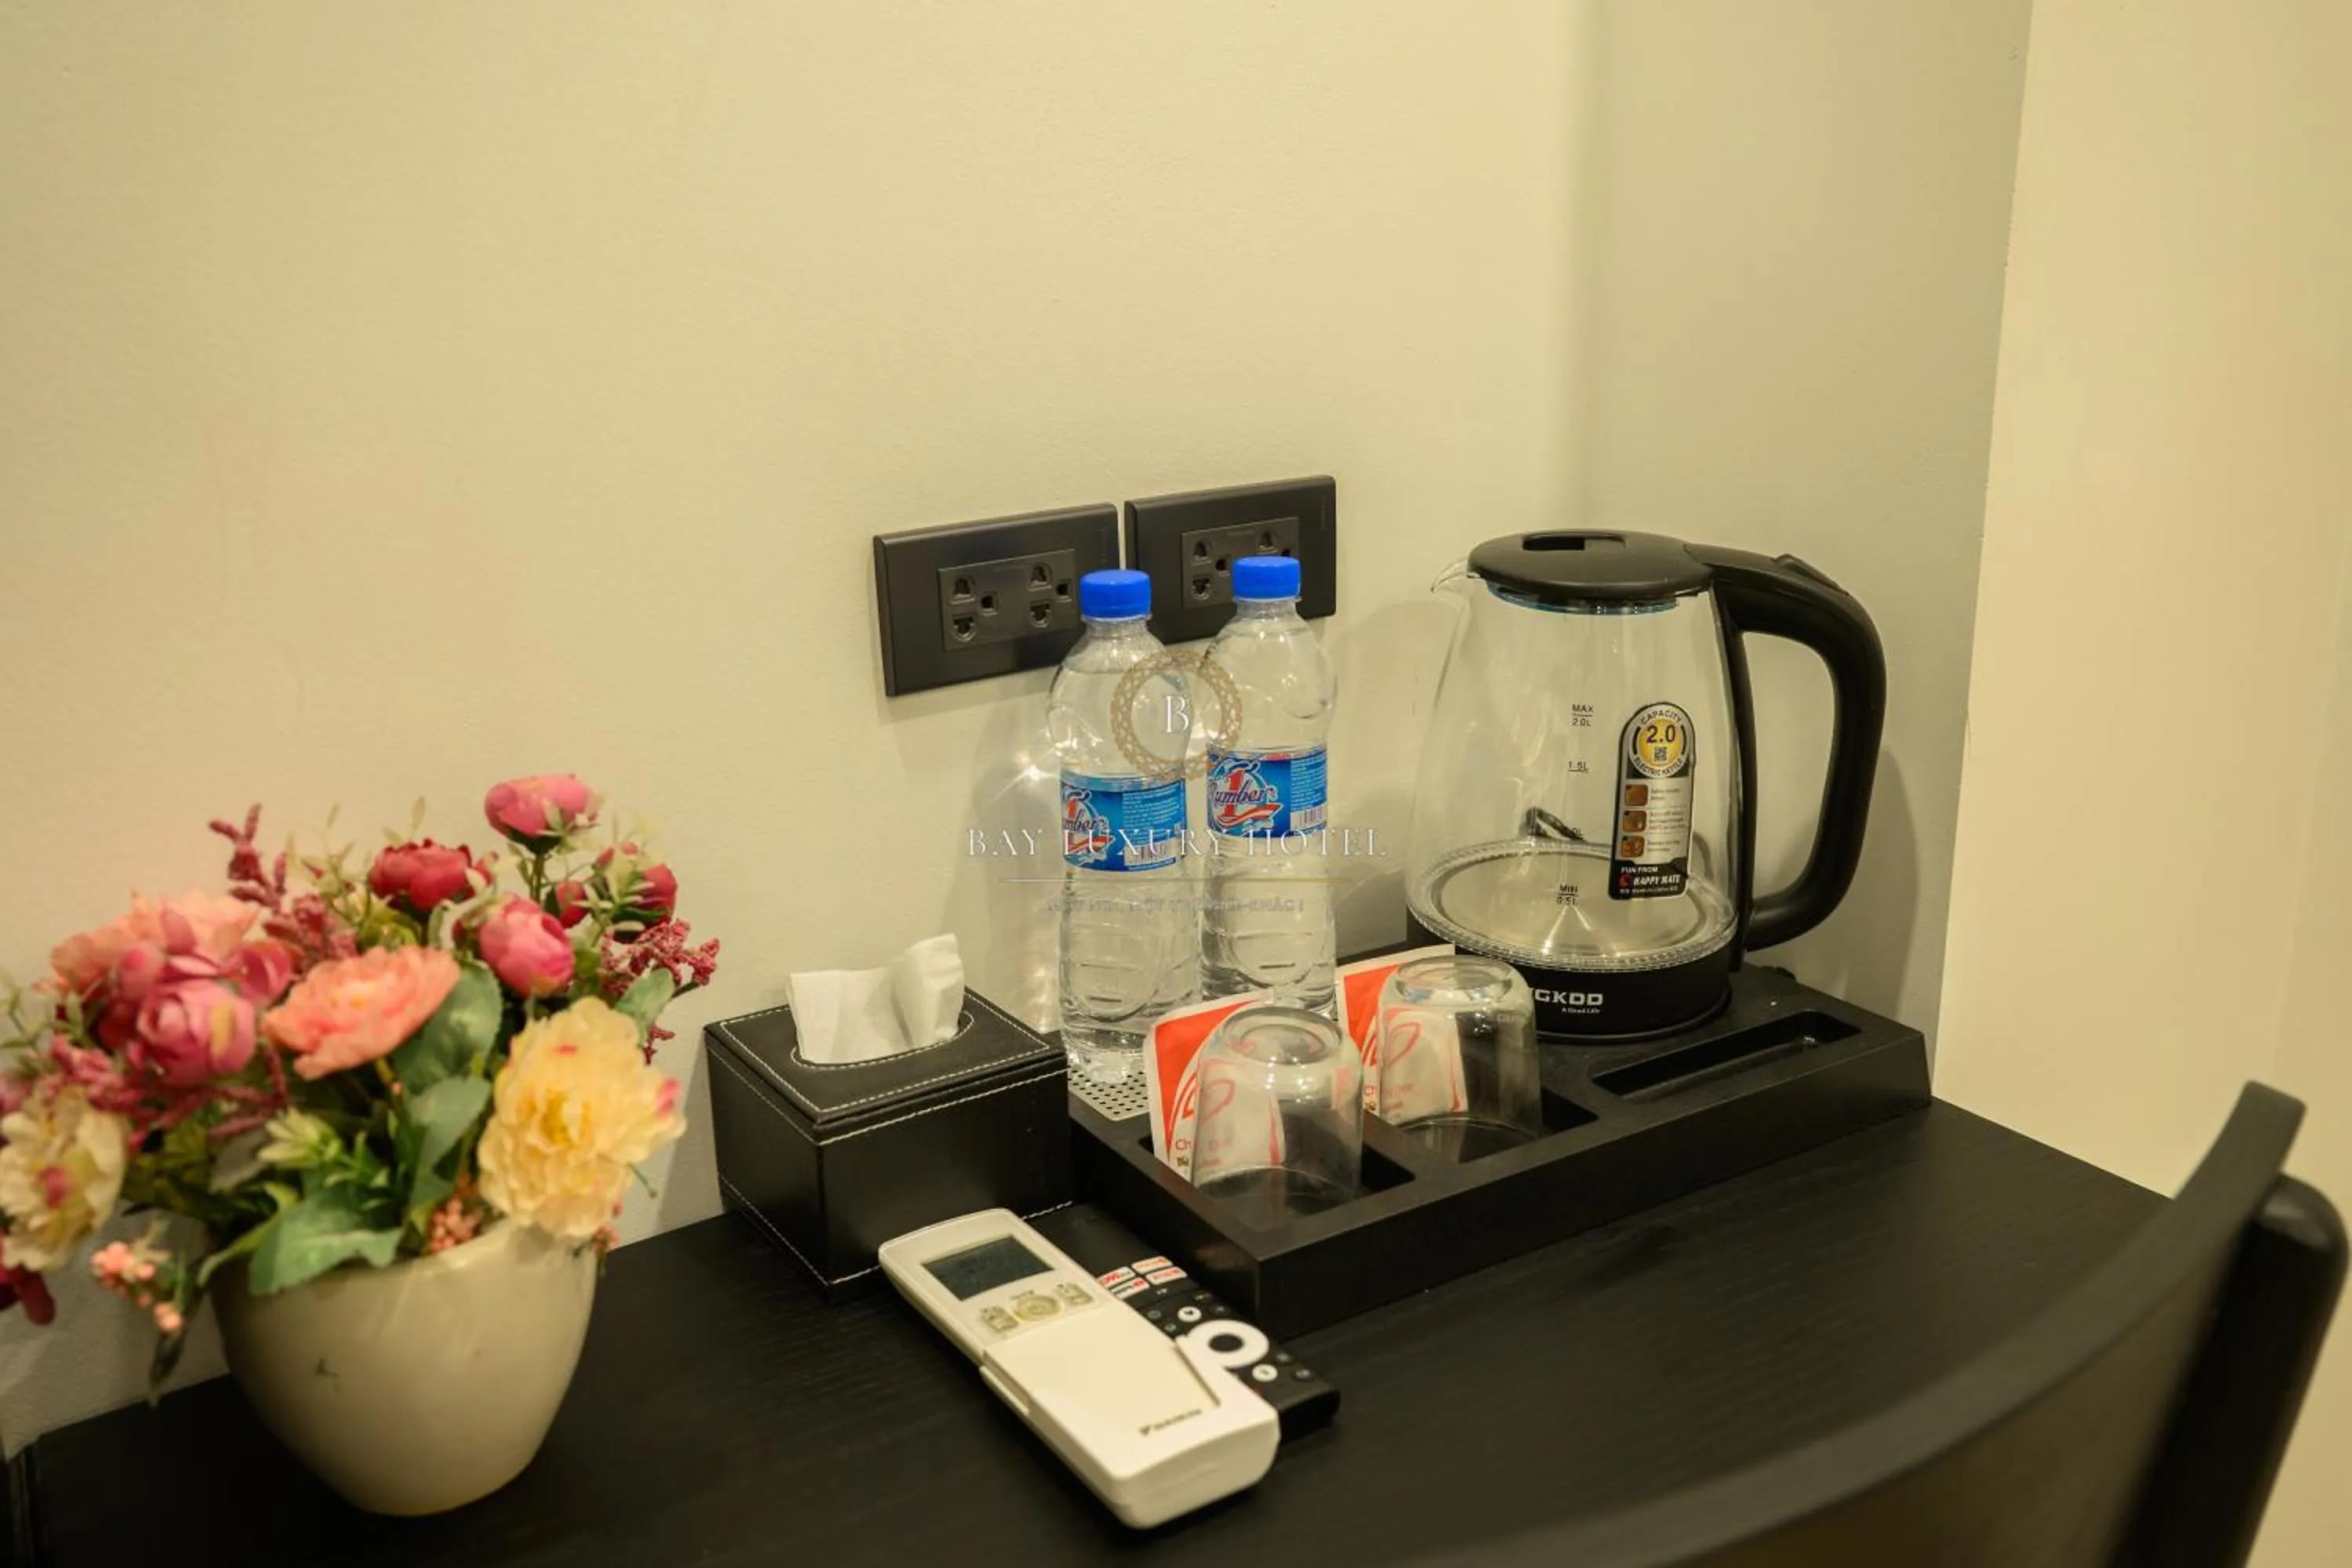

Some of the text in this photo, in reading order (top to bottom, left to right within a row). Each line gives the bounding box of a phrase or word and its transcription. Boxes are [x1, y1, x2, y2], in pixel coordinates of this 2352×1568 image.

[1572, 704, 1593, 713] MAX
[1641, 710, 1682, 725] CAPACITY
[1646, 724, 1676, 743] 2.0
